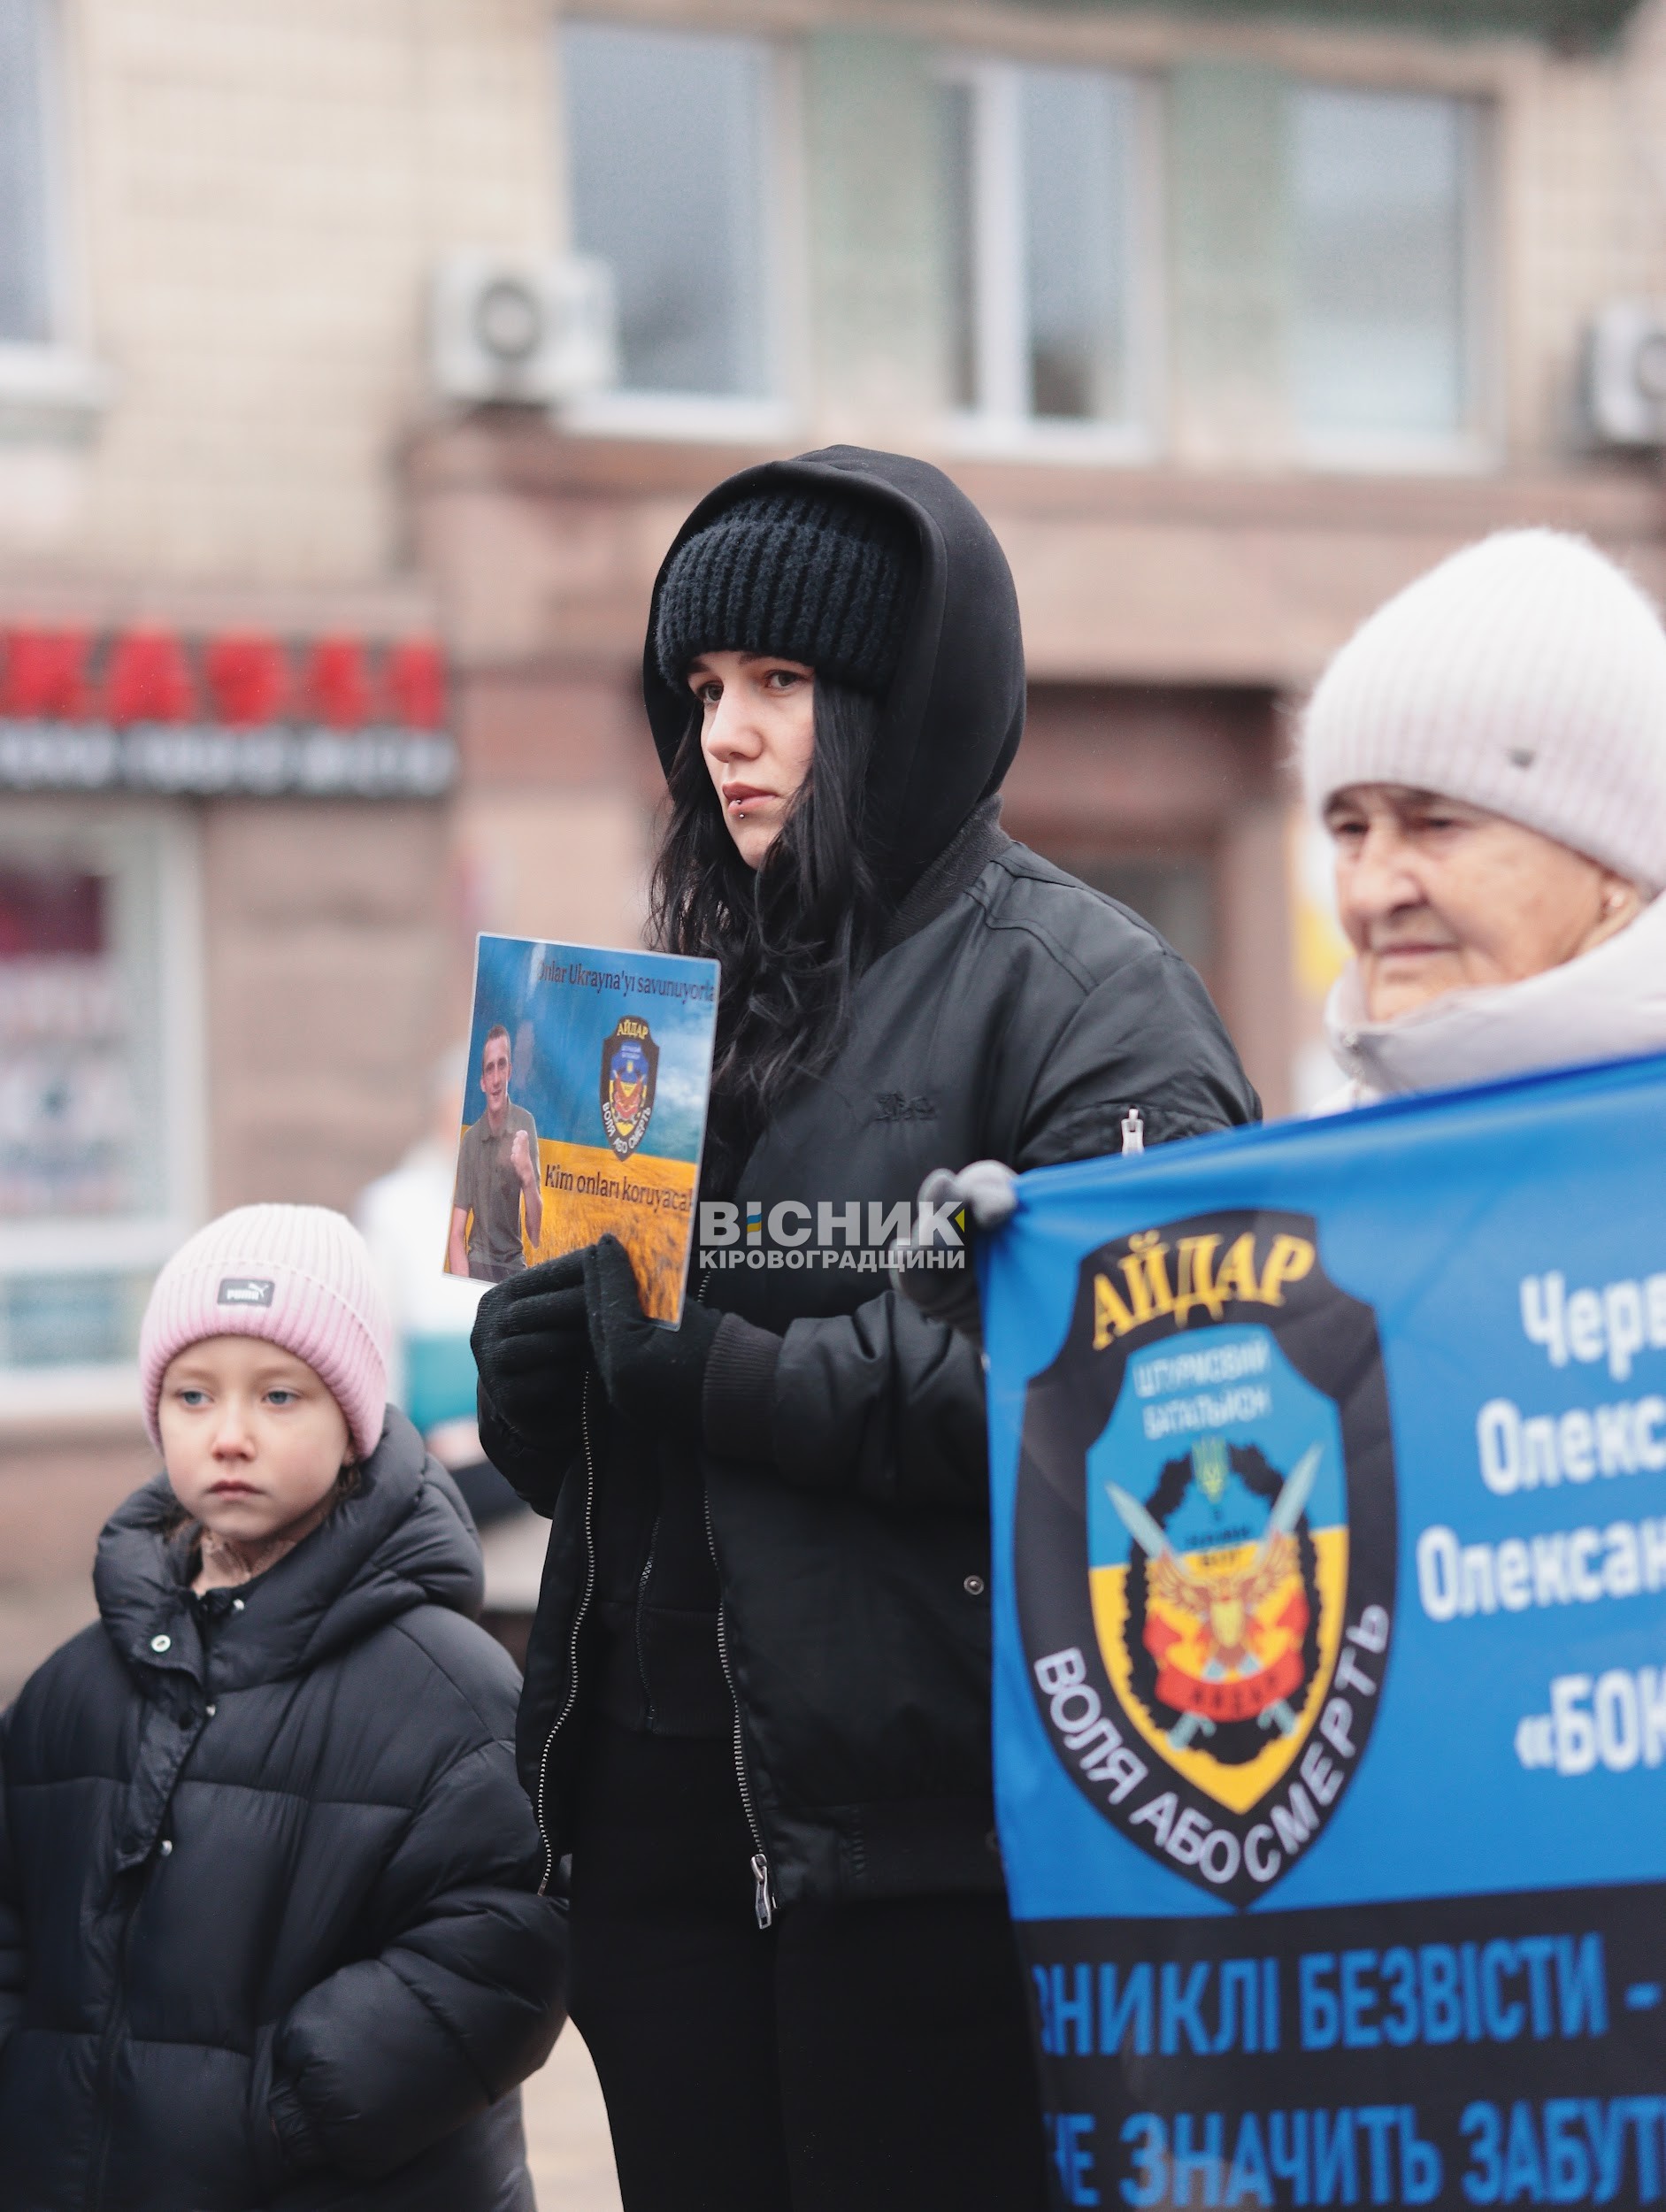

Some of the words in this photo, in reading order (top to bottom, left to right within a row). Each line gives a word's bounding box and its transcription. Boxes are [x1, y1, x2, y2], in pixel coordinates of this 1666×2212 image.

[569, 964, 635, 997] Ukrayna'yı
[617, 1019, 649, 1040] АЙДАР
[545, 1164, 573, 1192] Kim
[576, 1171, 619, 1199] onları
[1092, 1229, 1316, 1350] АЙДАР
[1478, 1395, 1666, 1495] Олекс
[1033, 1647, 1148, 1805] ВОЛЯ
[1129, 1792, 1240, 1884] АБО
[1243, 1604, 1390, 1882] СМЕРТЬ
[1299, 1932, 1608, 2051] БЕЗВІСТИ
[1044, 2112, 1100, 2207] Е
[1118, 2104, 1443, 2207] ЗНАЧИТЬ
